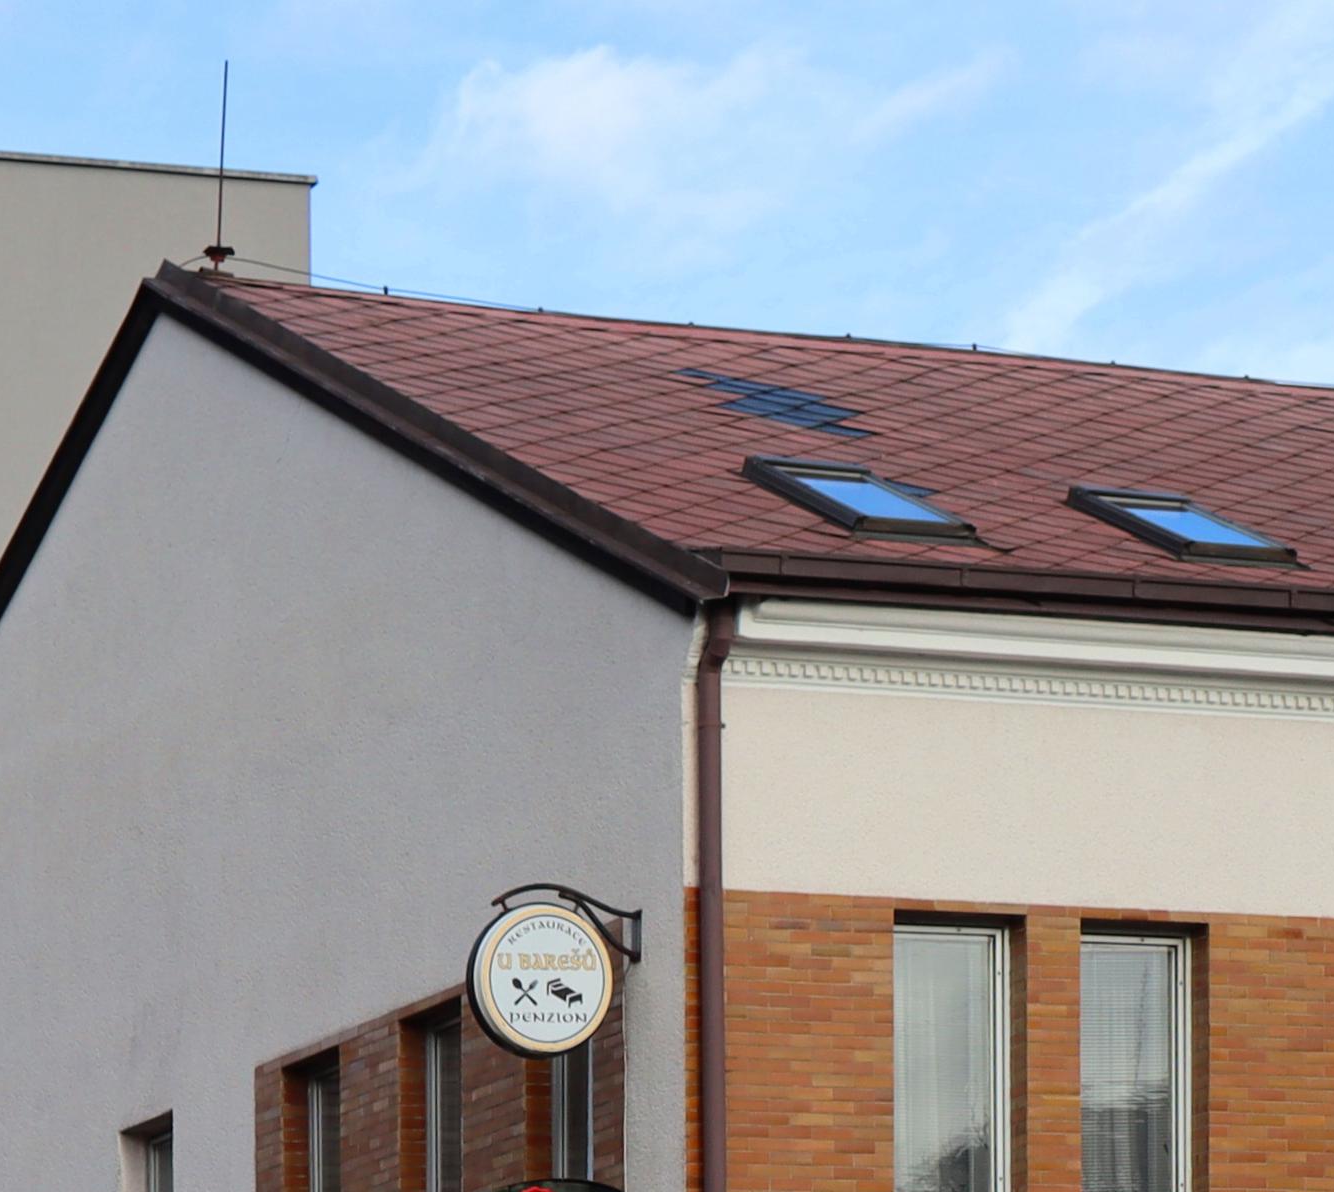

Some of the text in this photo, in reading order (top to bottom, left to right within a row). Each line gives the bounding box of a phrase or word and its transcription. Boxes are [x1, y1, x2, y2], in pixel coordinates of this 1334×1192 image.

[507, 919, 587, 946] RESTAURACE
[497, 947, 598, 972] U BAREŠŮ
[509, 1010, 588, 1025] PENZION
